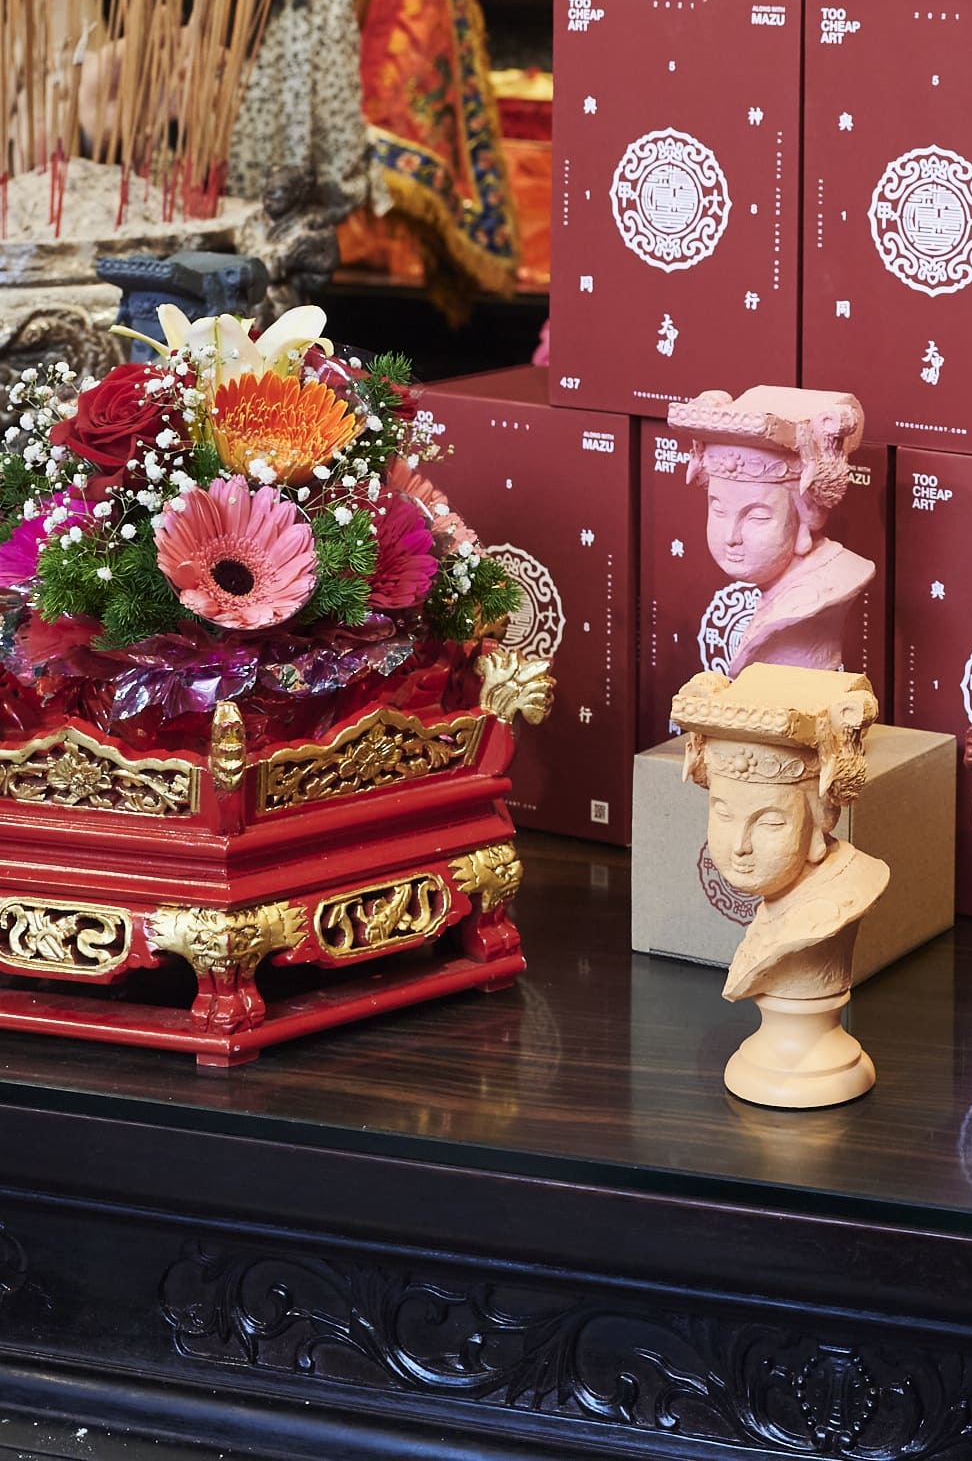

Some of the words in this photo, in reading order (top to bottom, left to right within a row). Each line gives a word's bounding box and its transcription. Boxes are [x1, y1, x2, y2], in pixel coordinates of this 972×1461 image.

[567, 7, 605, 20] CHEAP
[751, 12, 786, 27] MAZU
[820, 7, 847, 21] TOO
[567, 19, 590, 32] ART
[820, 19, 861, 34] CHEAP
[820, 32, 845, 45] ART
[668, 60, 676, 72] 5
[931, 74, 940, 86] 5
[747, 106, 764, 126] 神
[585, 189, 591, 200] 1
[750, 203, 758, 215] 8
[840, 210, 847, 221] 1
[579, 275, 594, 293] 同
[743, 290, 761, 311] 行
[835, 300, 851, 319] 同
[559, 376, 581, 390] 437
[414, 410, 434, 423] OO
[582, 435, 615, 453] MAZU
[654, 436, 678, 451] TOO
[654, 447, 692, 463] CHEAP
[654, 460, 679, 474] ART
[848, 472, 871, 486] AZU
[912, 472, 939, 488] TOO
[912, 484, 953, 503] CHEAP
[911, 498, 937, 511] ART
[578, 705, 593, 724] 行
